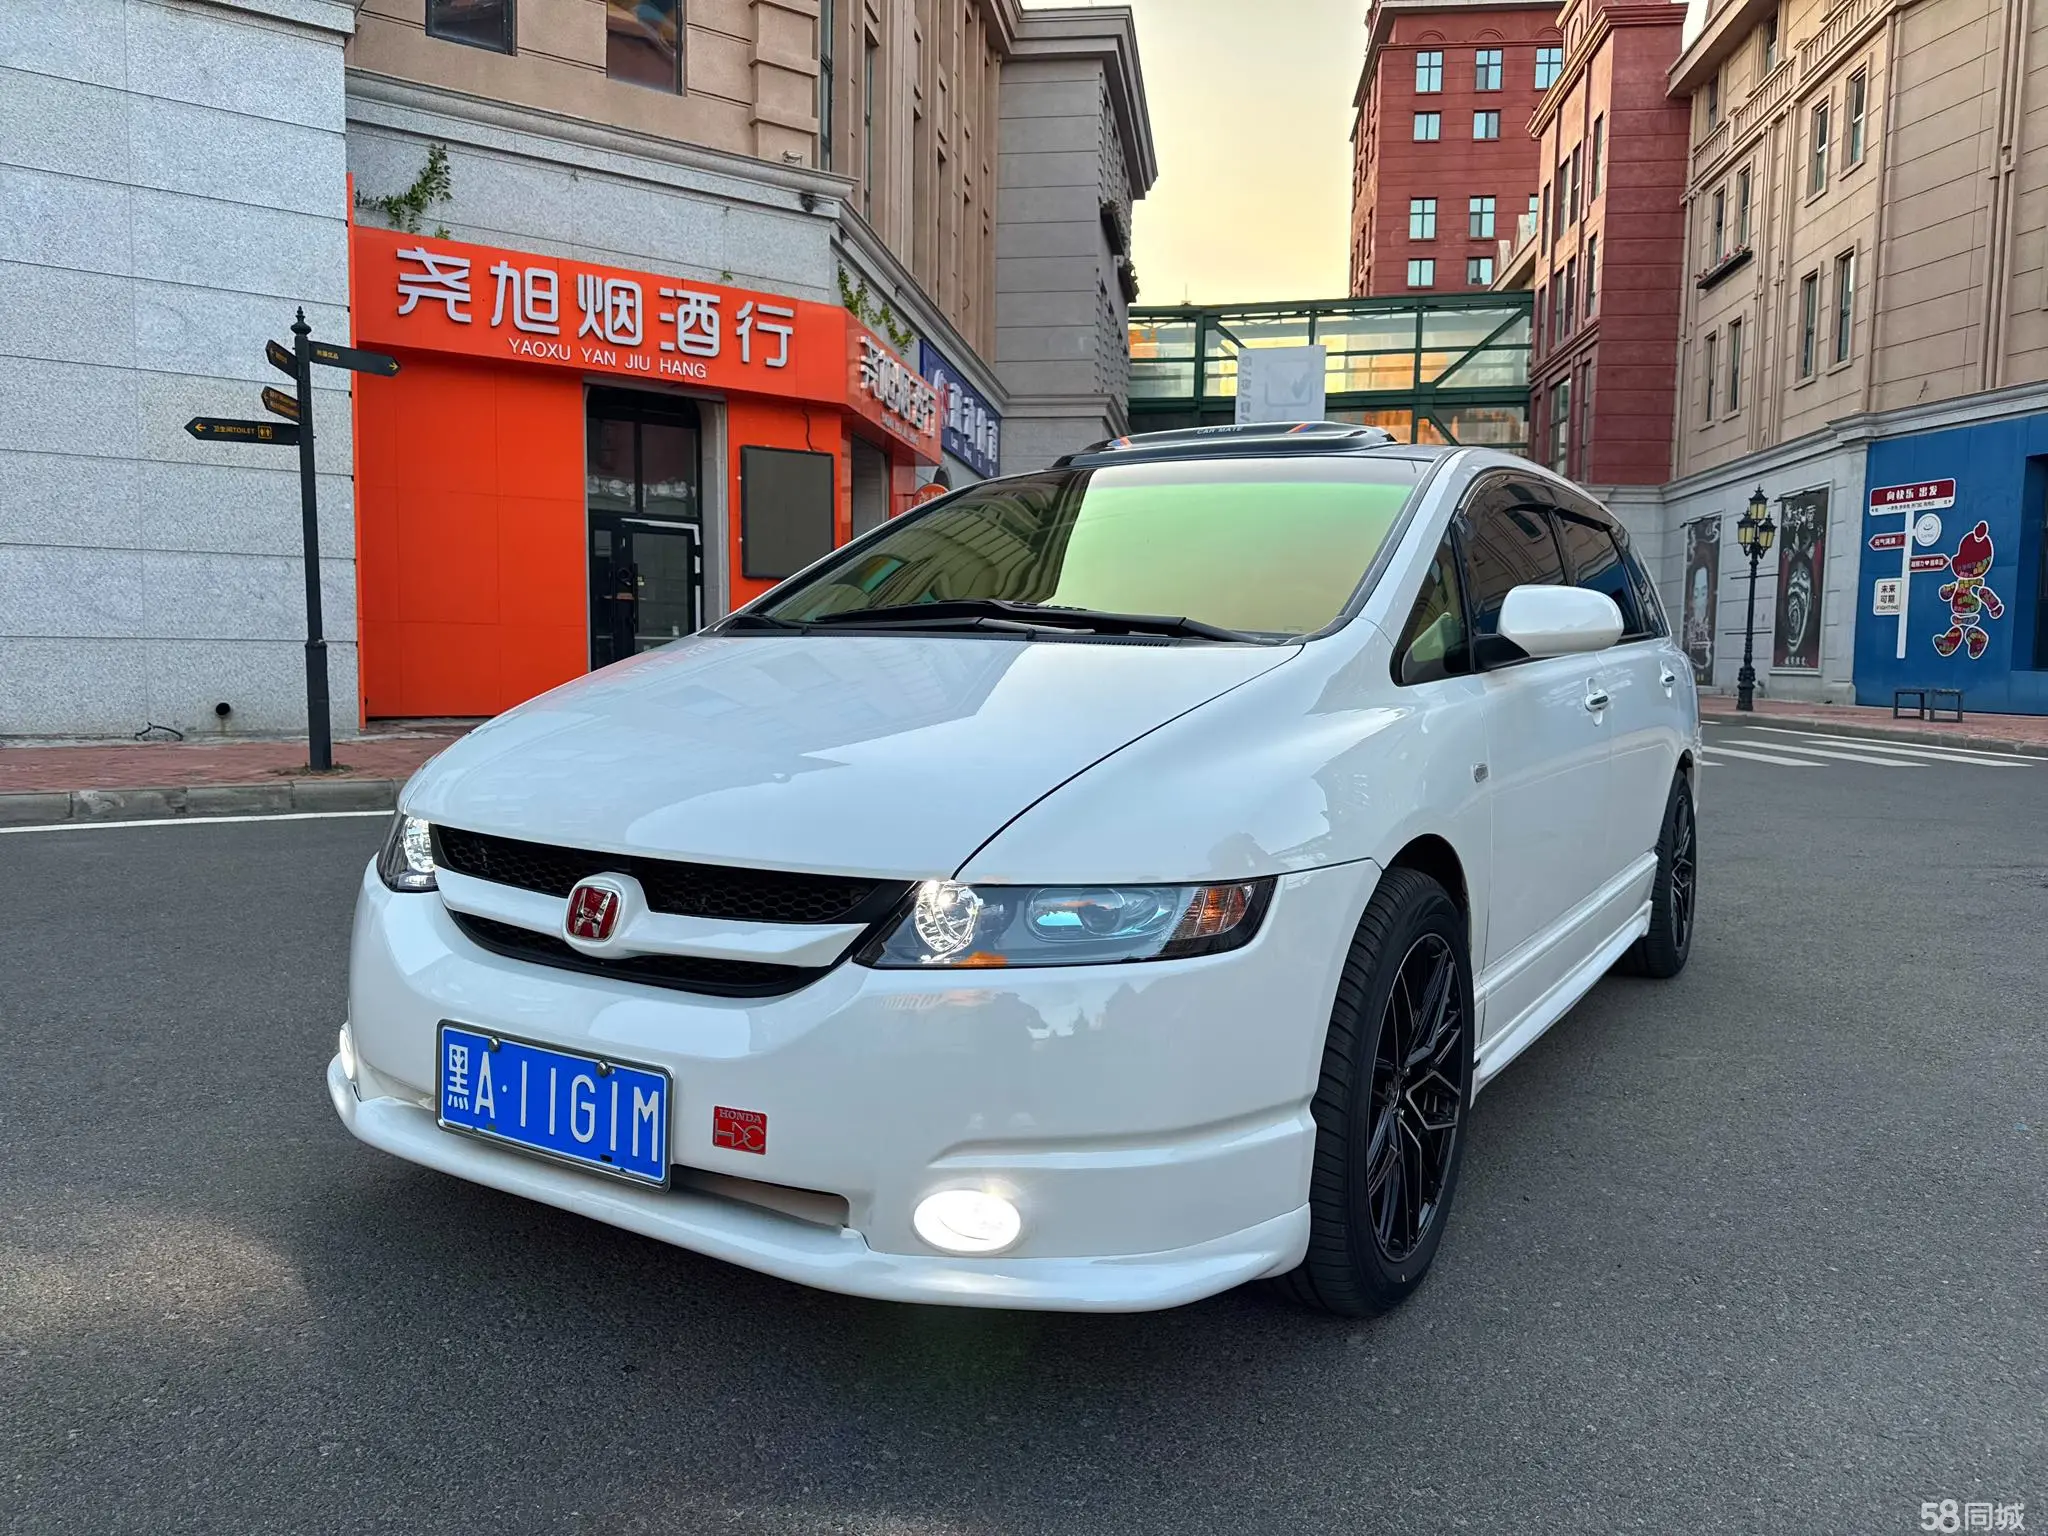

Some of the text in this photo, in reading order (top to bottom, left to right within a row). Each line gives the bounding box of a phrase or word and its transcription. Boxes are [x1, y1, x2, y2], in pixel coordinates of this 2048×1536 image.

[396, 246, 795, 368] 尧旭烟酒行
[508, 338, 708, 378] YAOXU YAN JIU HANG
[719, 1109, 763, 1125] HONDA
